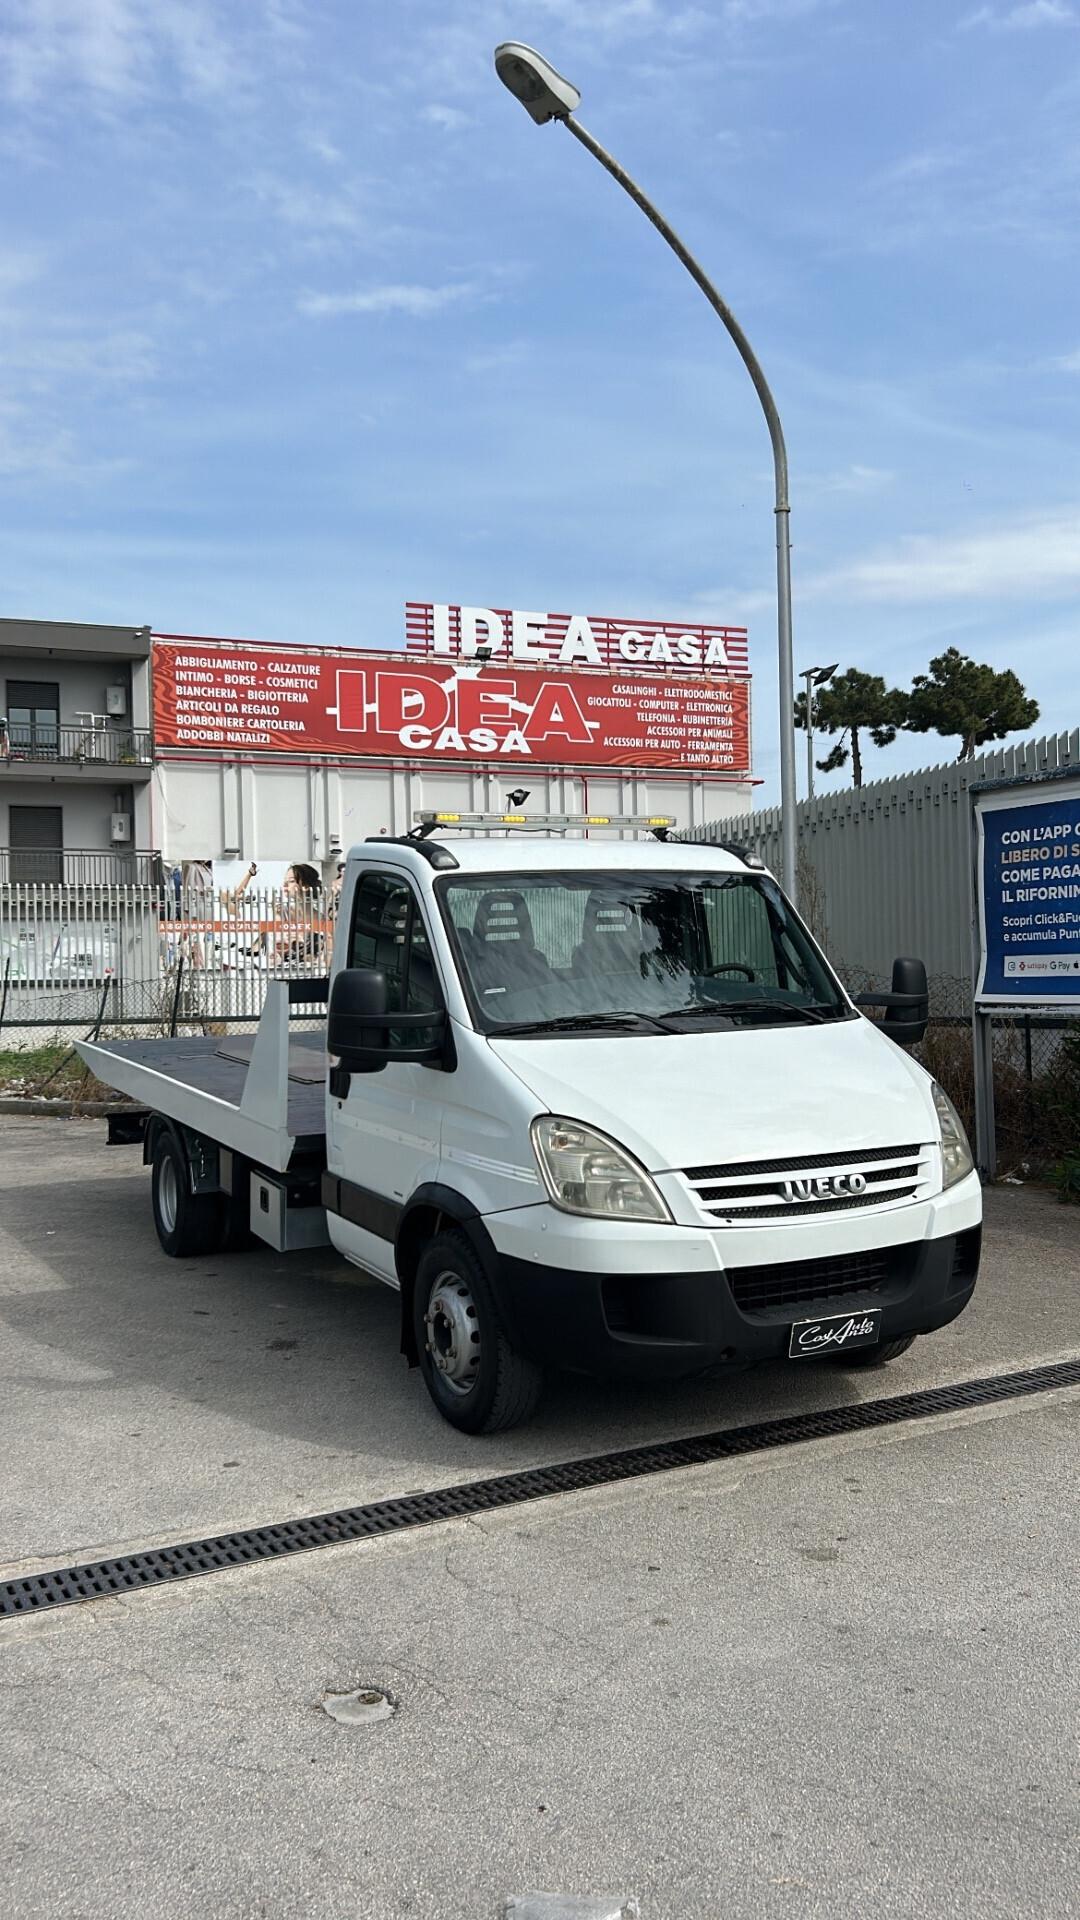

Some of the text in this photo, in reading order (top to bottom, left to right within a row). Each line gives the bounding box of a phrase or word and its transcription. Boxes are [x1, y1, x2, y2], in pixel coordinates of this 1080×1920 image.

[433, 604, 728, 665] IDEA CASA
[175, 656, 257, 671] ABBIGLIAMENTO
[268, 663, 320, 675] CALZATURE
[176, 671, 213, 682] INTIMO
[225, 675, 256, 686] BORSE
[266, 677, 317, 689] COSMETICI
[176, 686, 237, 698] BIANCHERIA
[248, 691, 308, 703] BIGIOTTERIA
[612, 685, 656, 696] CASALINGHI
[664, 688, 732, 700] ELETTRODOMESTICI
[176, 700, 279, 715] ARTICOLI DA REGALO
[336, 670, 594, 742] IDEA
[587, 697, 631, 707] GIOCATTOLI
[639, 700, 679, 710] COMPUTER
[686, 703, 733, 713] ELETTRONICA
[177, 715, 305, 731] BOMBONIERE CARTOLERIA
[637, 712, 675, 723] TELEFONIA
[683, 716, 733, 726] RUBINETTERIA
[177, 729, 270, 743] ADDOBBI NATALIZI
[399, 725, 532, 753] CASA
[647, 726, 732, 739] ACCESSORI PER ANIMALI
[604, 737, 643, 747] ACCESSORI
[645, 739, 658, 748] PER
[661, 740, 680, 749] AUTO
[688, 741, 733, 751] FERRAMENTA
[687, 754, 709, 763] TANTO
[712, 755, 733, 764] ALTRO
[1001, 829, 1030, 844] CON
[1034, 824, 1071, 841] L'APP
[1001, 847, 1050, 864] LIBERO
[1054, 845, 1068, 859] DI
[1001, 868, 1040, 883] COME
[1002, 890, 1014, 903] IL
[1003, 913, 1080, 927] Scopri Click&Fu
[1003, 933, 1010, 942] e
[1011, 929, 1056, 941] accumula
[782, 1173, 867, 1202] IVECO
